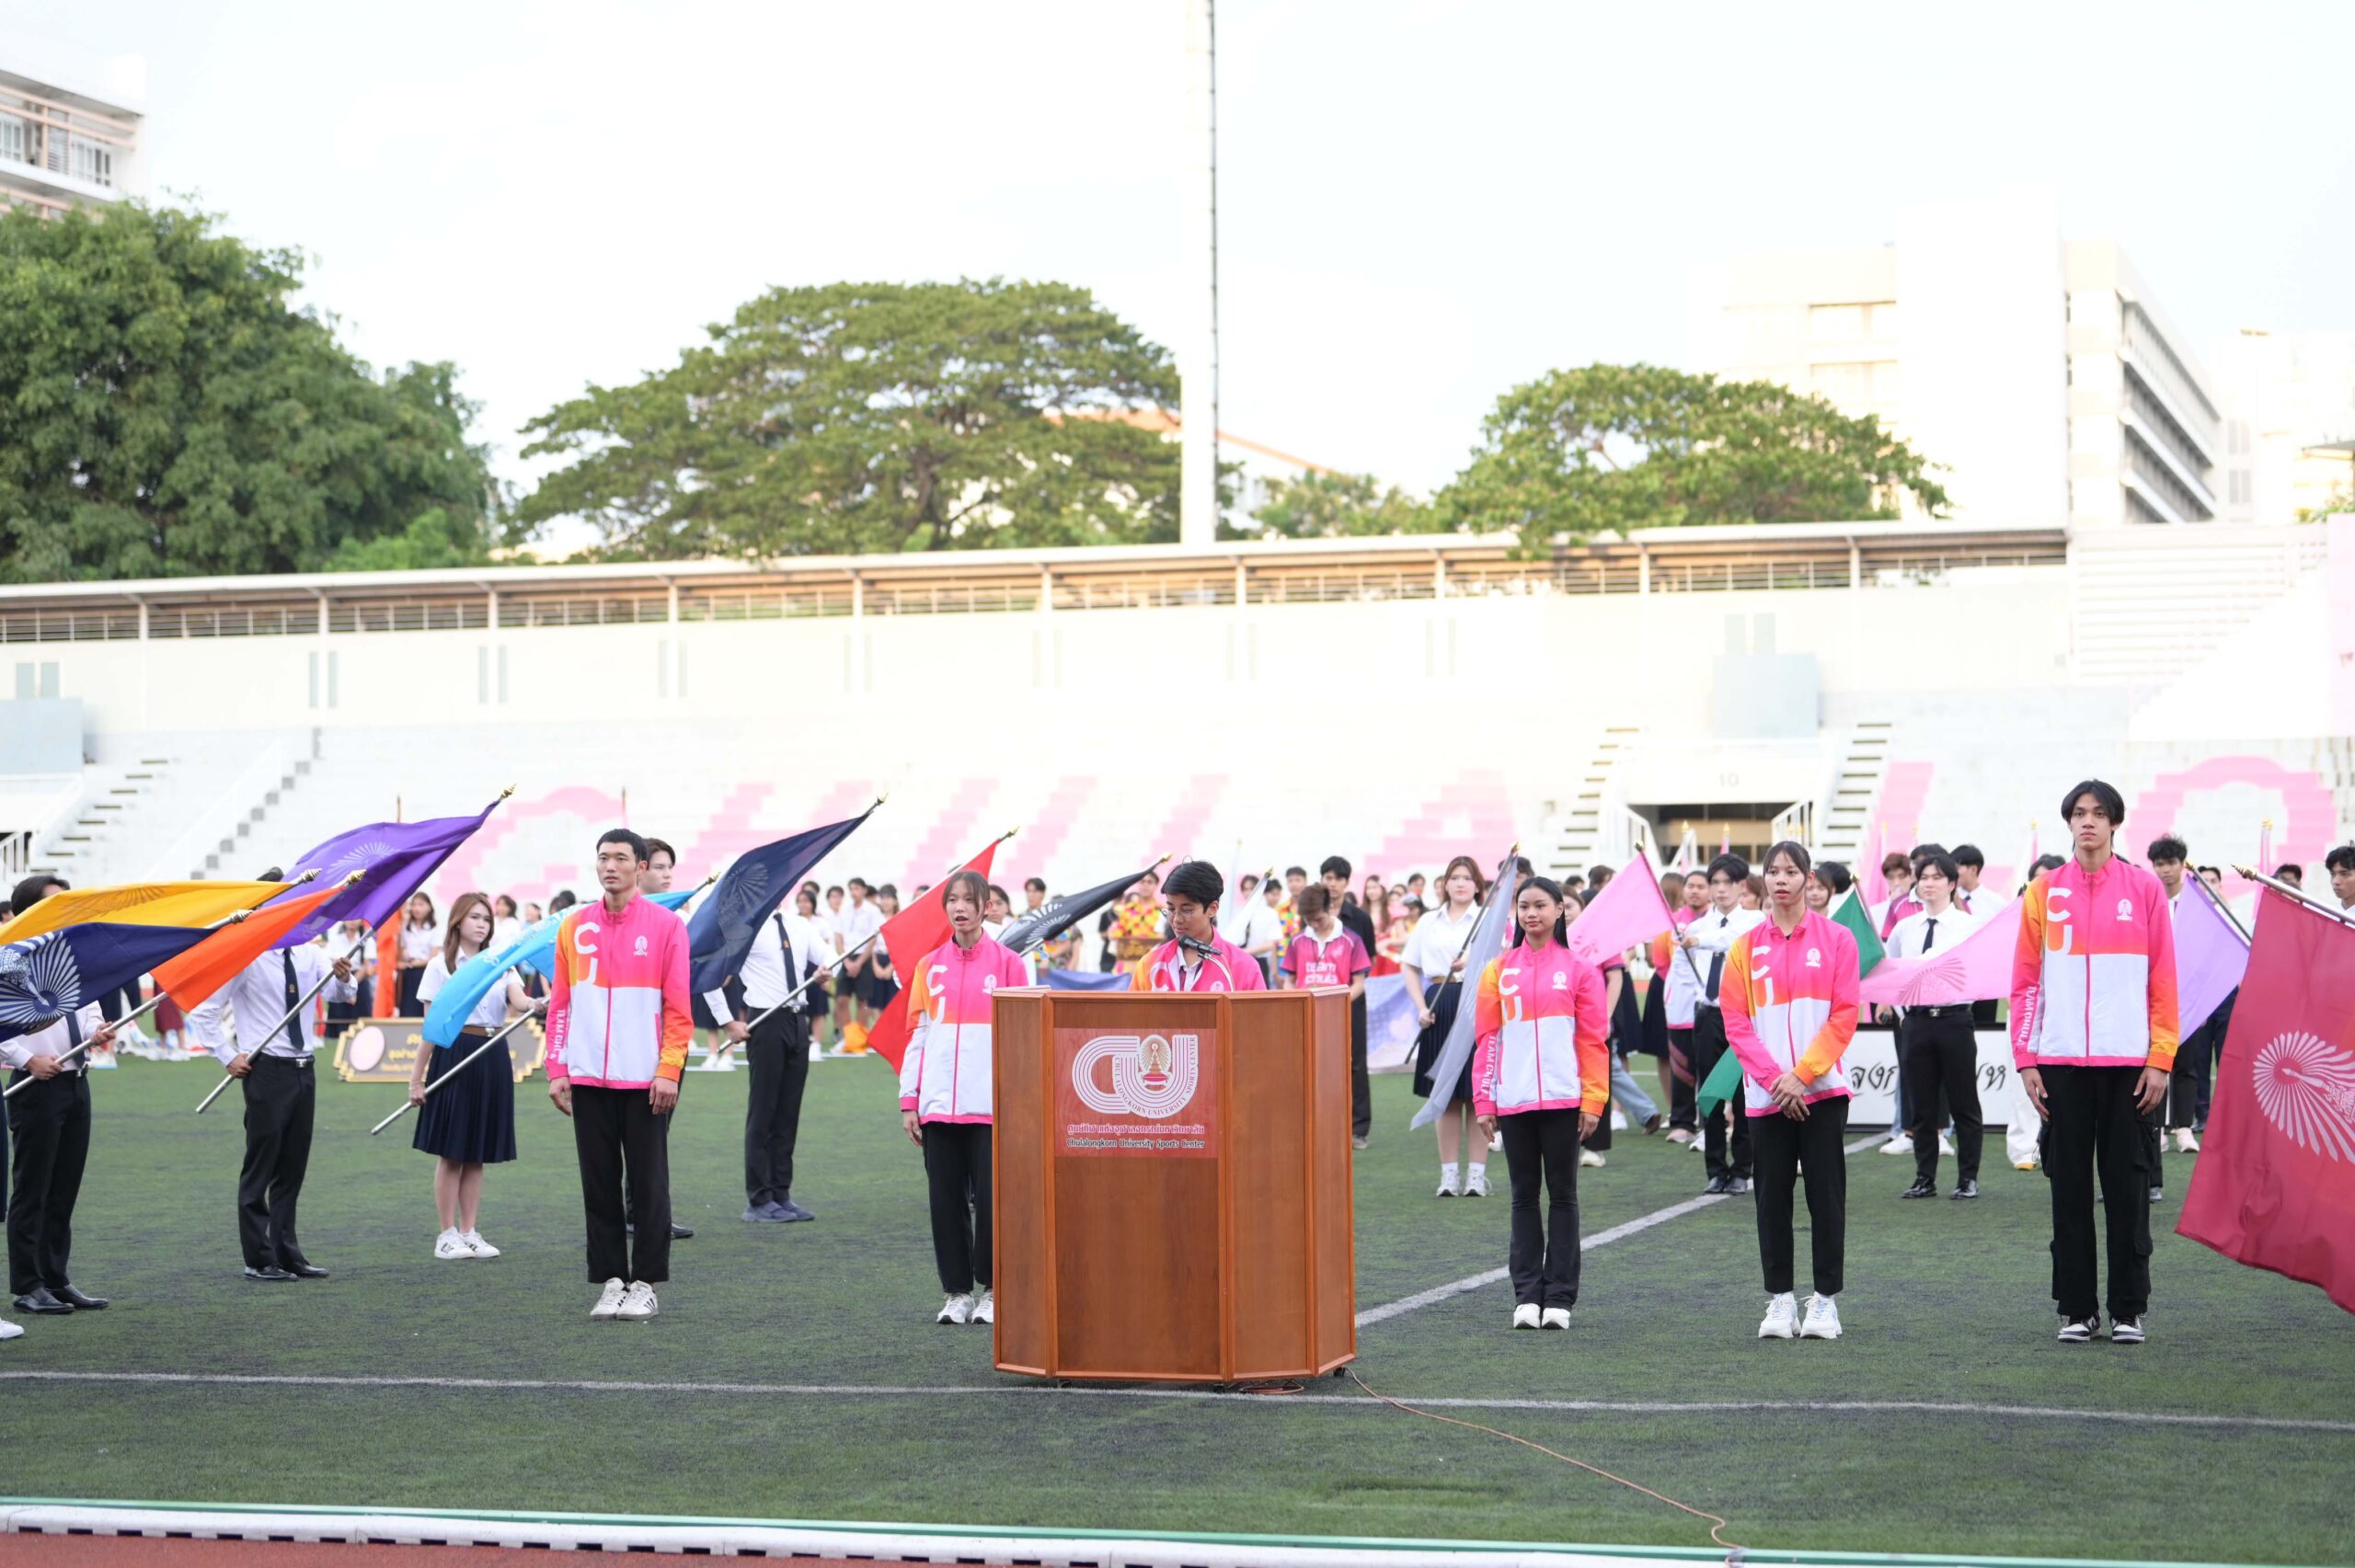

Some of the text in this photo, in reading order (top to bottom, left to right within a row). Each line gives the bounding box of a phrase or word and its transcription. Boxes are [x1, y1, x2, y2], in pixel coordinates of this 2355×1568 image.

[1719, 773, 1740, 788] 10
[1305, 960, 1337, 973] team
[1304, 973, 1338, 985] chula
[2025, 986, 2037, 1012] TEAM
[549, 1009, 566, 1059] TEAM CHA
[1486, 1036, 1496, 1064] TEAM
[1147, 1096, 1187, 1116] UNIVERSITY
[1186, 1067, 1196, 1095] SPORTS
[1067, 1138, 1204, 1150] Chulalongkorn University Sports Center
